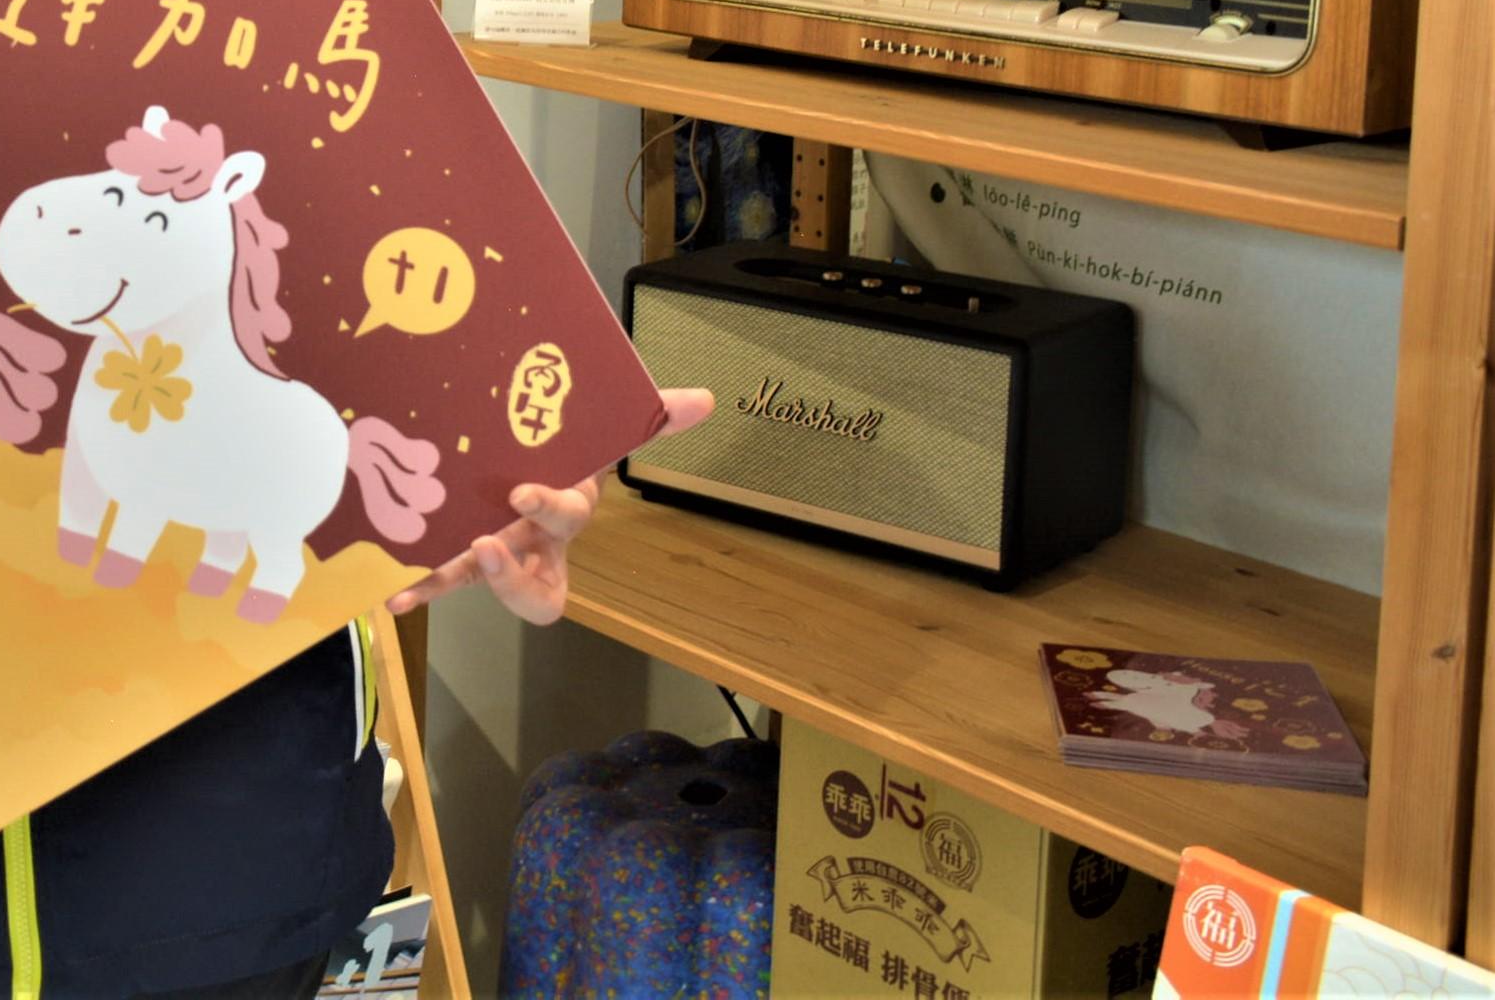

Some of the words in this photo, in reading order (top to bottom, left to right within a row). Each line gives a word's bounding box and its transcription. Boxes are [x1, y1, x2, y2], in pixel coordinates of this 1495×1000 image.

[860, 37, 1008, 69] TELEFUNKEN
[735, 376, 883, 440] Marshall
[825, 783, 872, 823] 乖乖
[788, 903, 871, 974] 奮起福
